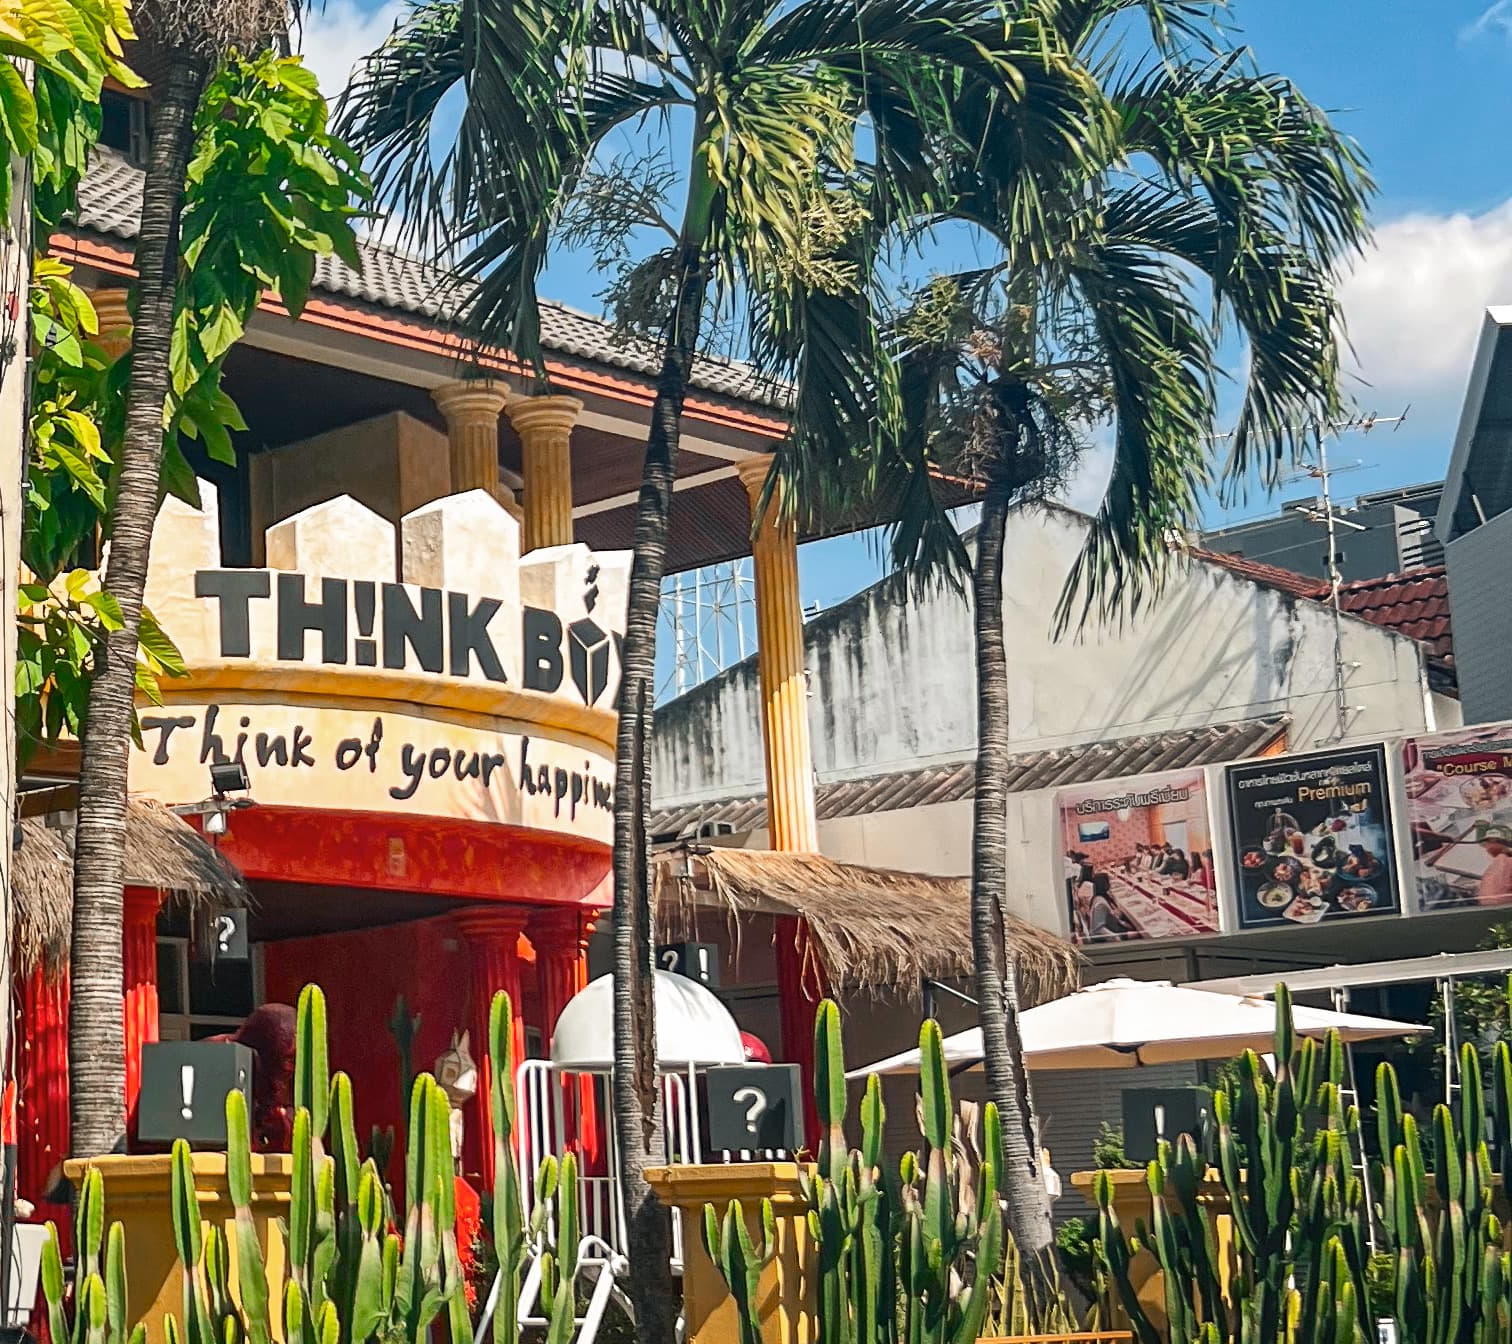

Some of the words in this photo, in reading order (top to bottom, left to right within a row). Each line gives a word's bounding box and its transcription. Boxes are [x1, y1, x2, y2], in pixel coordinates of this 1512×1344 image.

[195, 570, 507, 686] TH!NK
[140, 704, 316, 773] Think
[335, 716, 384, 774] of
[389, 743, 505, 800] your
[1297, 782, 1372, 802] Premium
[214, 915, 236, 953] ?
[698, 947, 710, 982] !
[181, 1065, 194, 1121] !
[732, 1086, 768, 1134] ?
